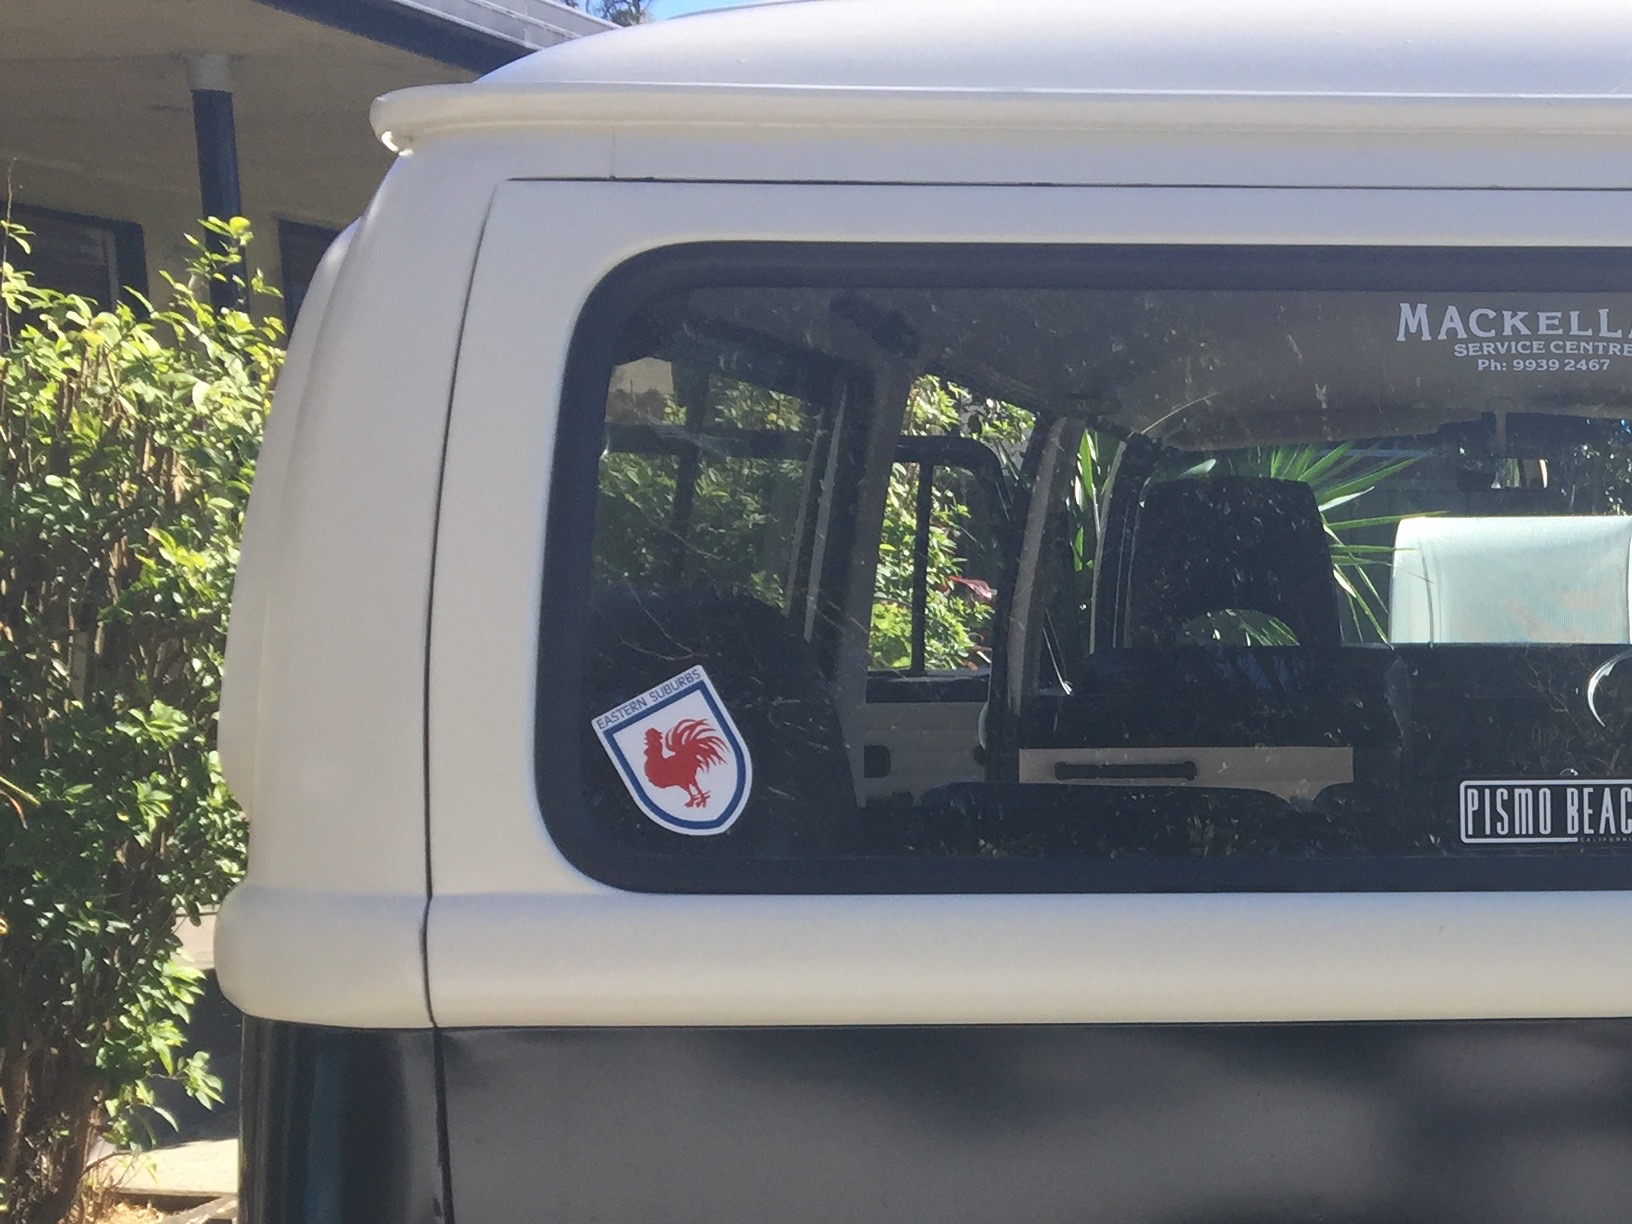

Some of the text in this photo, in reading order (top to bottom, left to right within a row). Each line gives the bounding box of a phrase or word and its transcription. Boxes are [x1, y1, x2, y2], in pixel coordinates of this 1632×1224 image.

[1453, 342, 1546, 357] SERVICE
[1477, 359, 1611, 371] Ph: 9939 2467
[596, 669, 701, 729] EASTERN SUBURBS
[1466, 787, 1552, 836] PISMO
